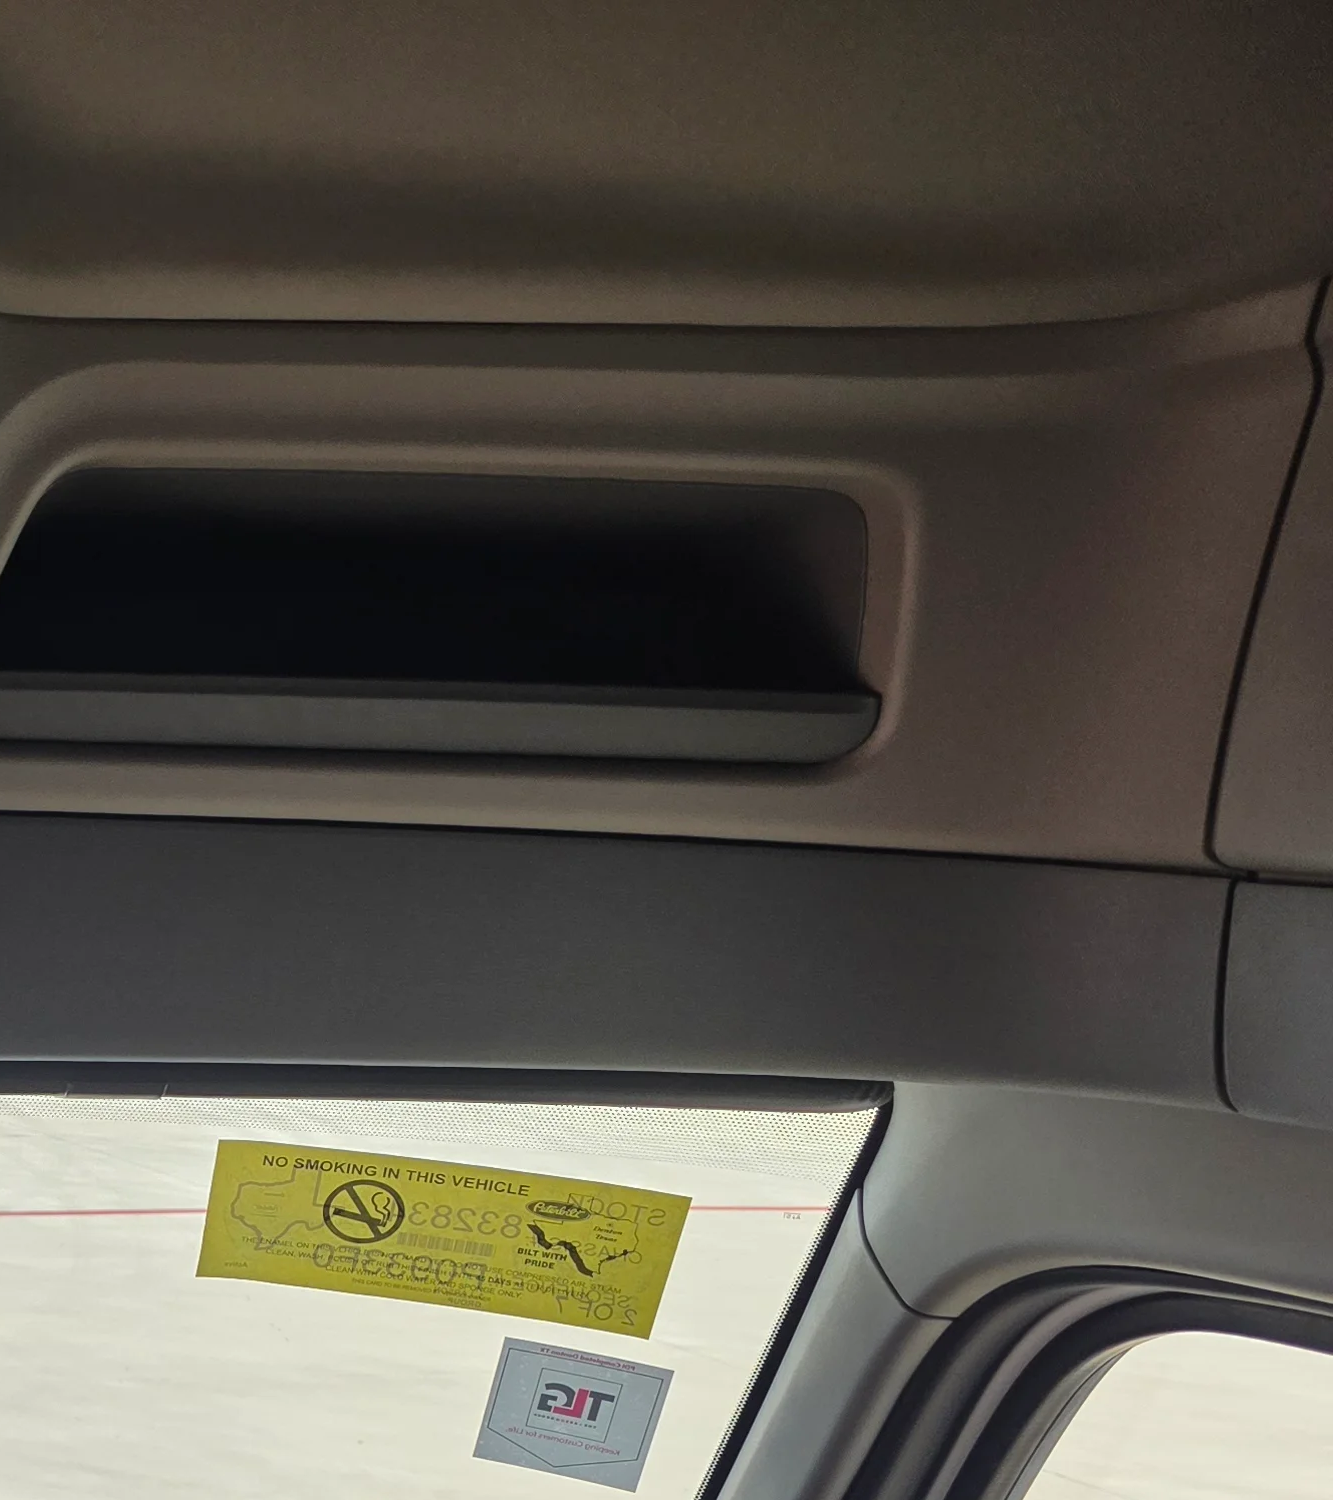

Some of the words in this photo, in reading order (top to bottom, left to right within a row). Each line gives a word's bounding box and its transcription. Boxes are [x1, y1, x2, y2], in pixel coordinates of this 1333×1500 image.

[263, 1155, 288, 1167] NO
[294, 1158, 378, 1177] SMOKING
[383, 1167, 400, 1179] IN
[406, 1169, 446, 1185] THIS
[452, 1175, 530, 1197] VEHICLE
[533, 1202, 585, 1219] Peterbilt
[517, 1248, 539, 1256] BILT
[542, 1253, 567, 1262] WITH
[259, 1237, 293, 1247] ENAMEL
[296, 1241, 309, 1249] ON
[484, 1266, 501, 1274] USE
[505, 1269, 570, 1285] COMPRESSED
[590, 1282, 621, 1294] STEAM
[325, 1264, 354, 1274] CLEAN
[356, 1268, 378, 1277] WITH
[525, 1259, 555, 1269] PRIDE
[487, 1276, 511, 1286] DAYS
